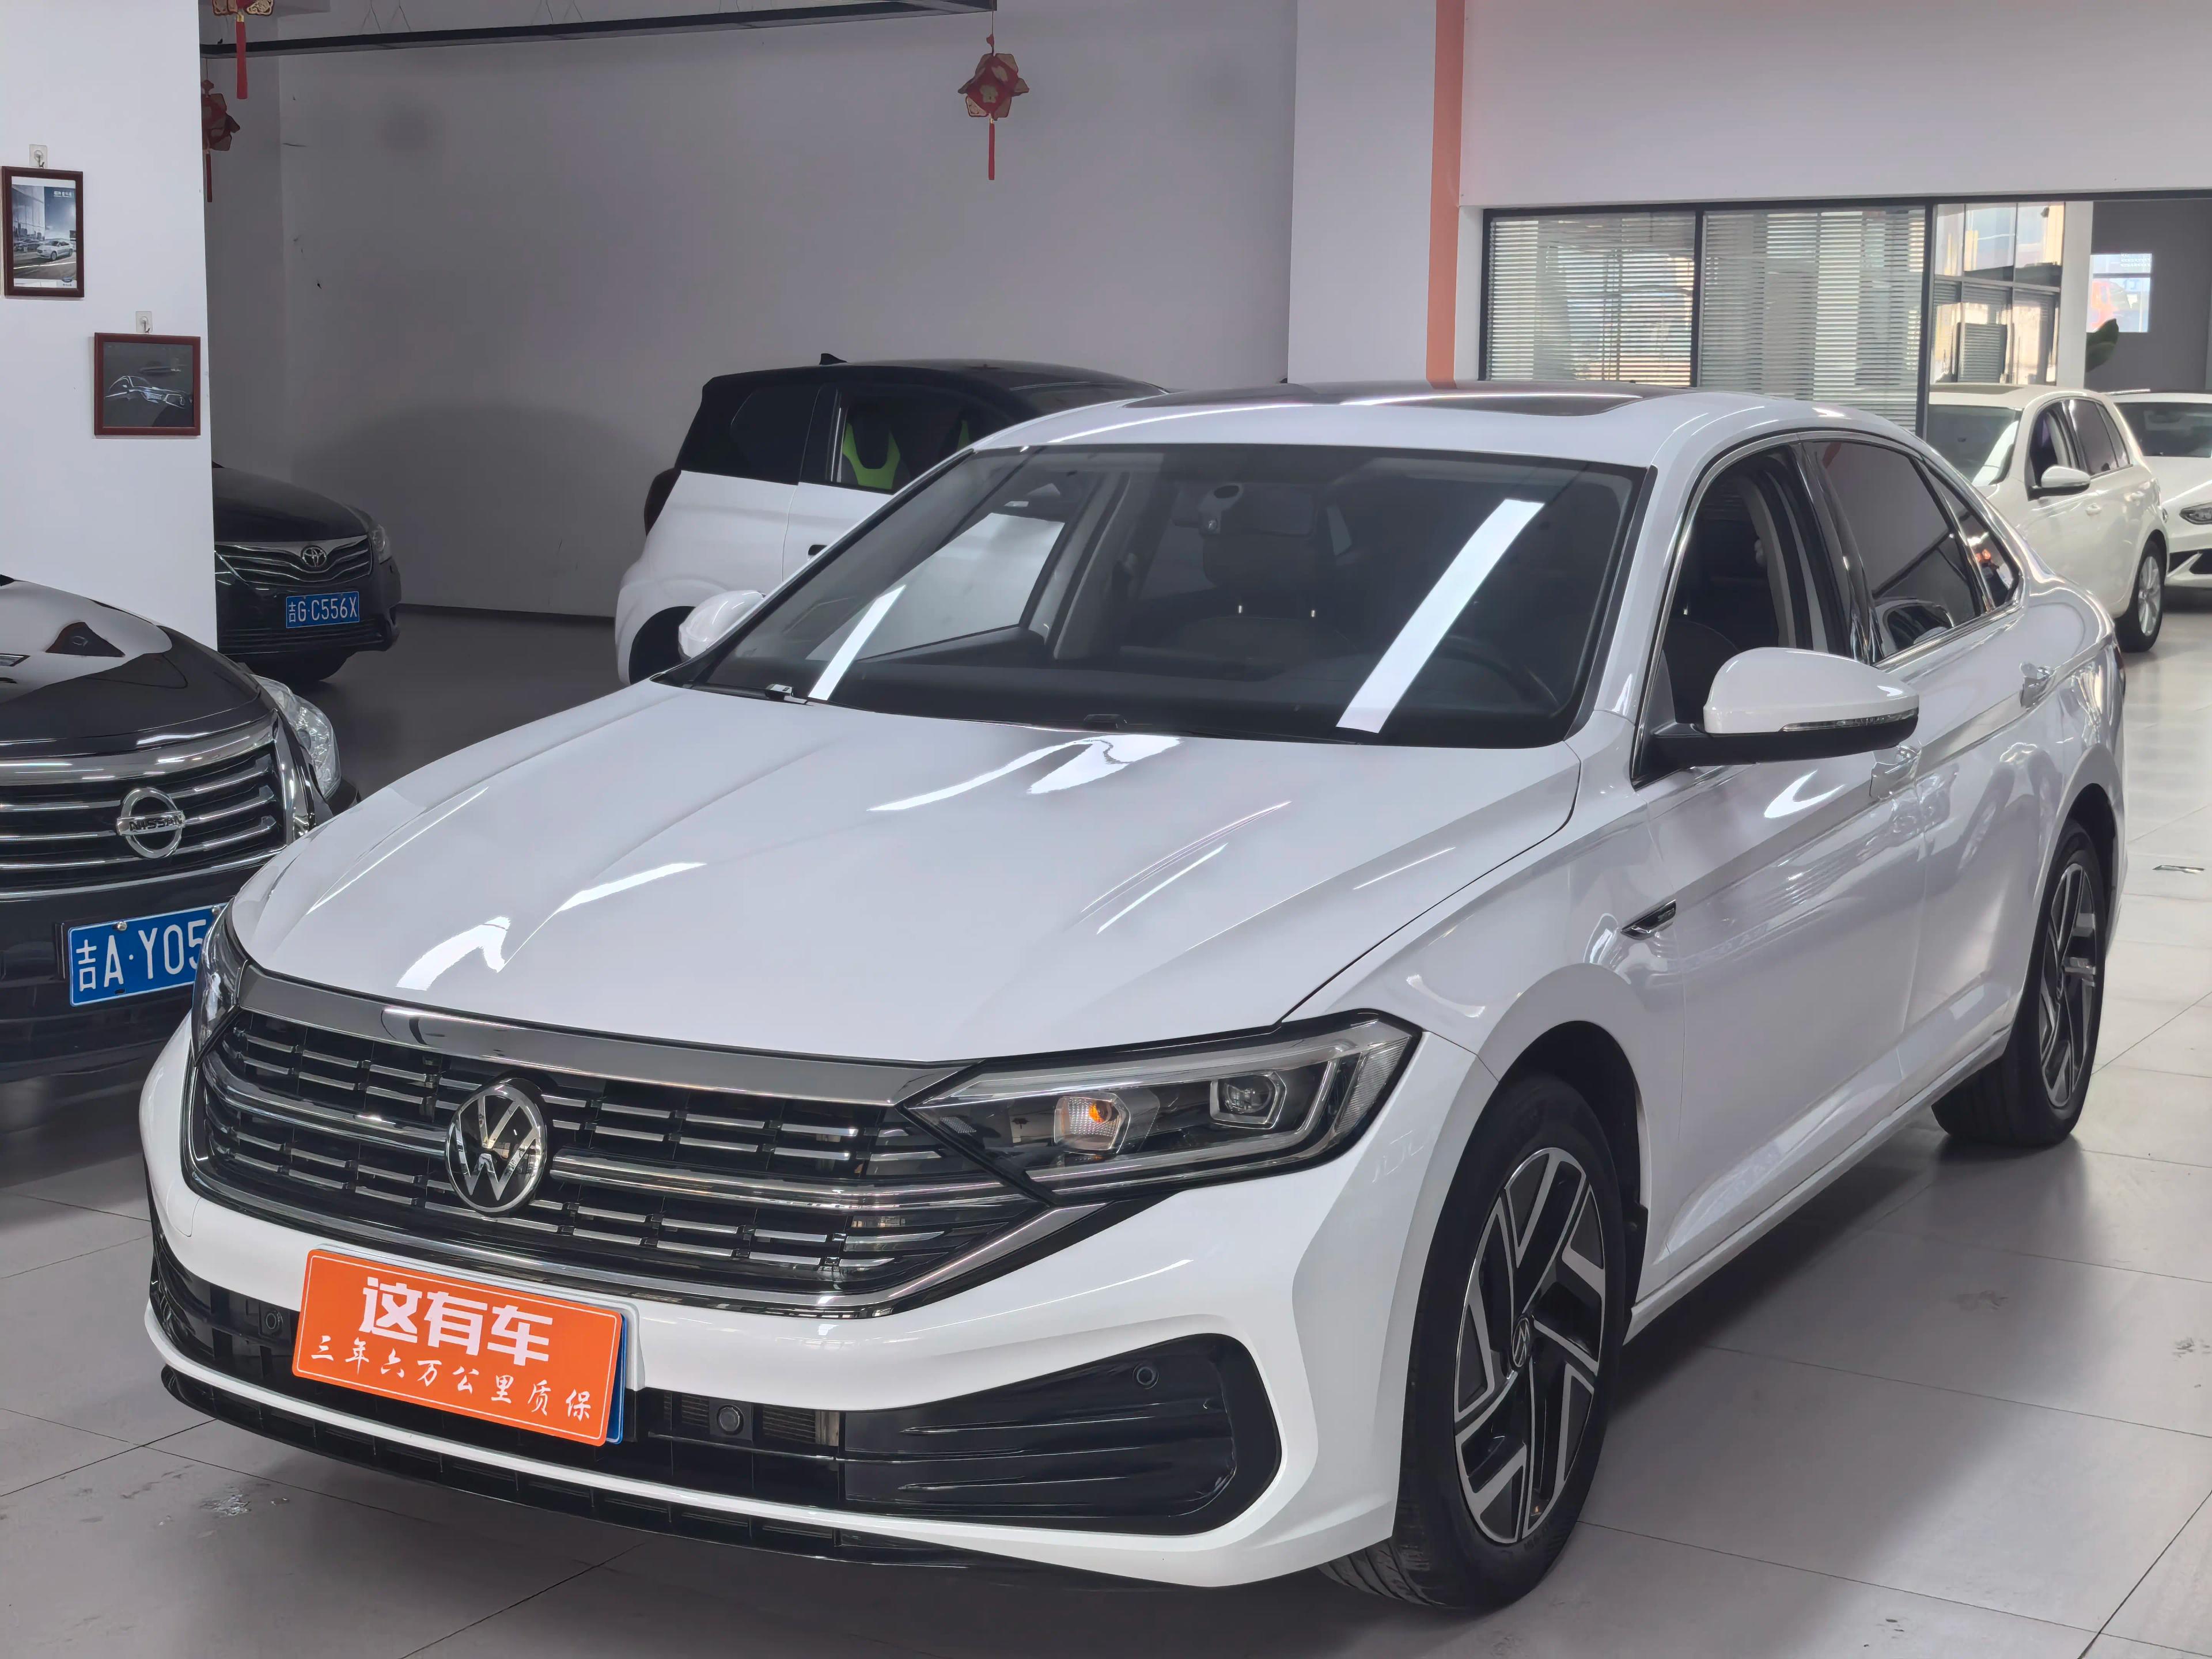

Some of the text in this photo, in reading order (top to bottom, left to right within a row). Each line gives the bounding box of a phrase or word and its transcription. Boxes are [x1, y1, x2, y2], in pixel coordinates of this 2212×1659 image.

[129, 813, 183, 831] NISSAN
[358, 1276, 554, 1366] 这有车
[310, 1335, 592, 1422] 三年六万公里质保
